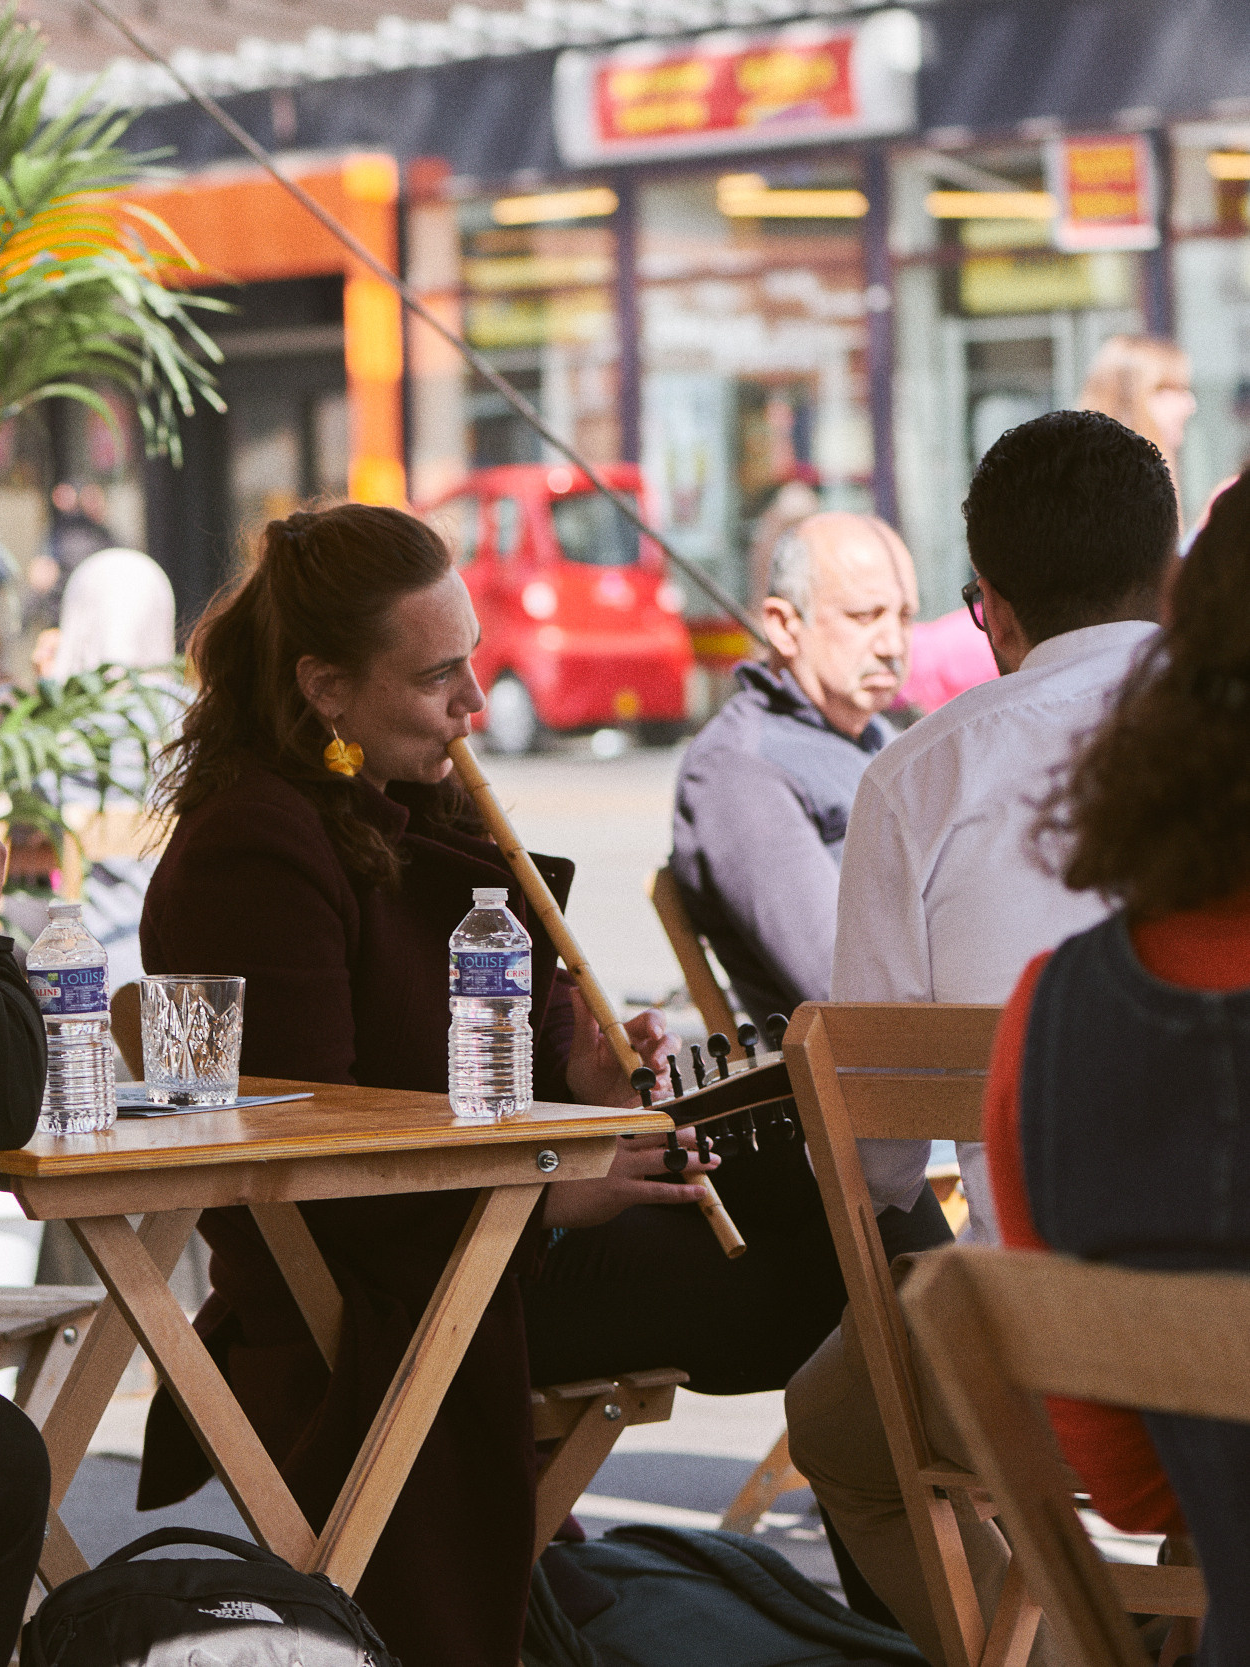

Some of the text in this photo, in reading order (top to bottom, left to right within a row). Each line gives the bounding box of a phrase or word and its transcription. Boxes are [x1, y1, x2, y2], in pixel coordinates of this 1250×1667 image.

[459, 956, 506, 968] LOUISE
[60, 971, 104, 985] LOUISE
[219, 1600, 252, 1609] THE
